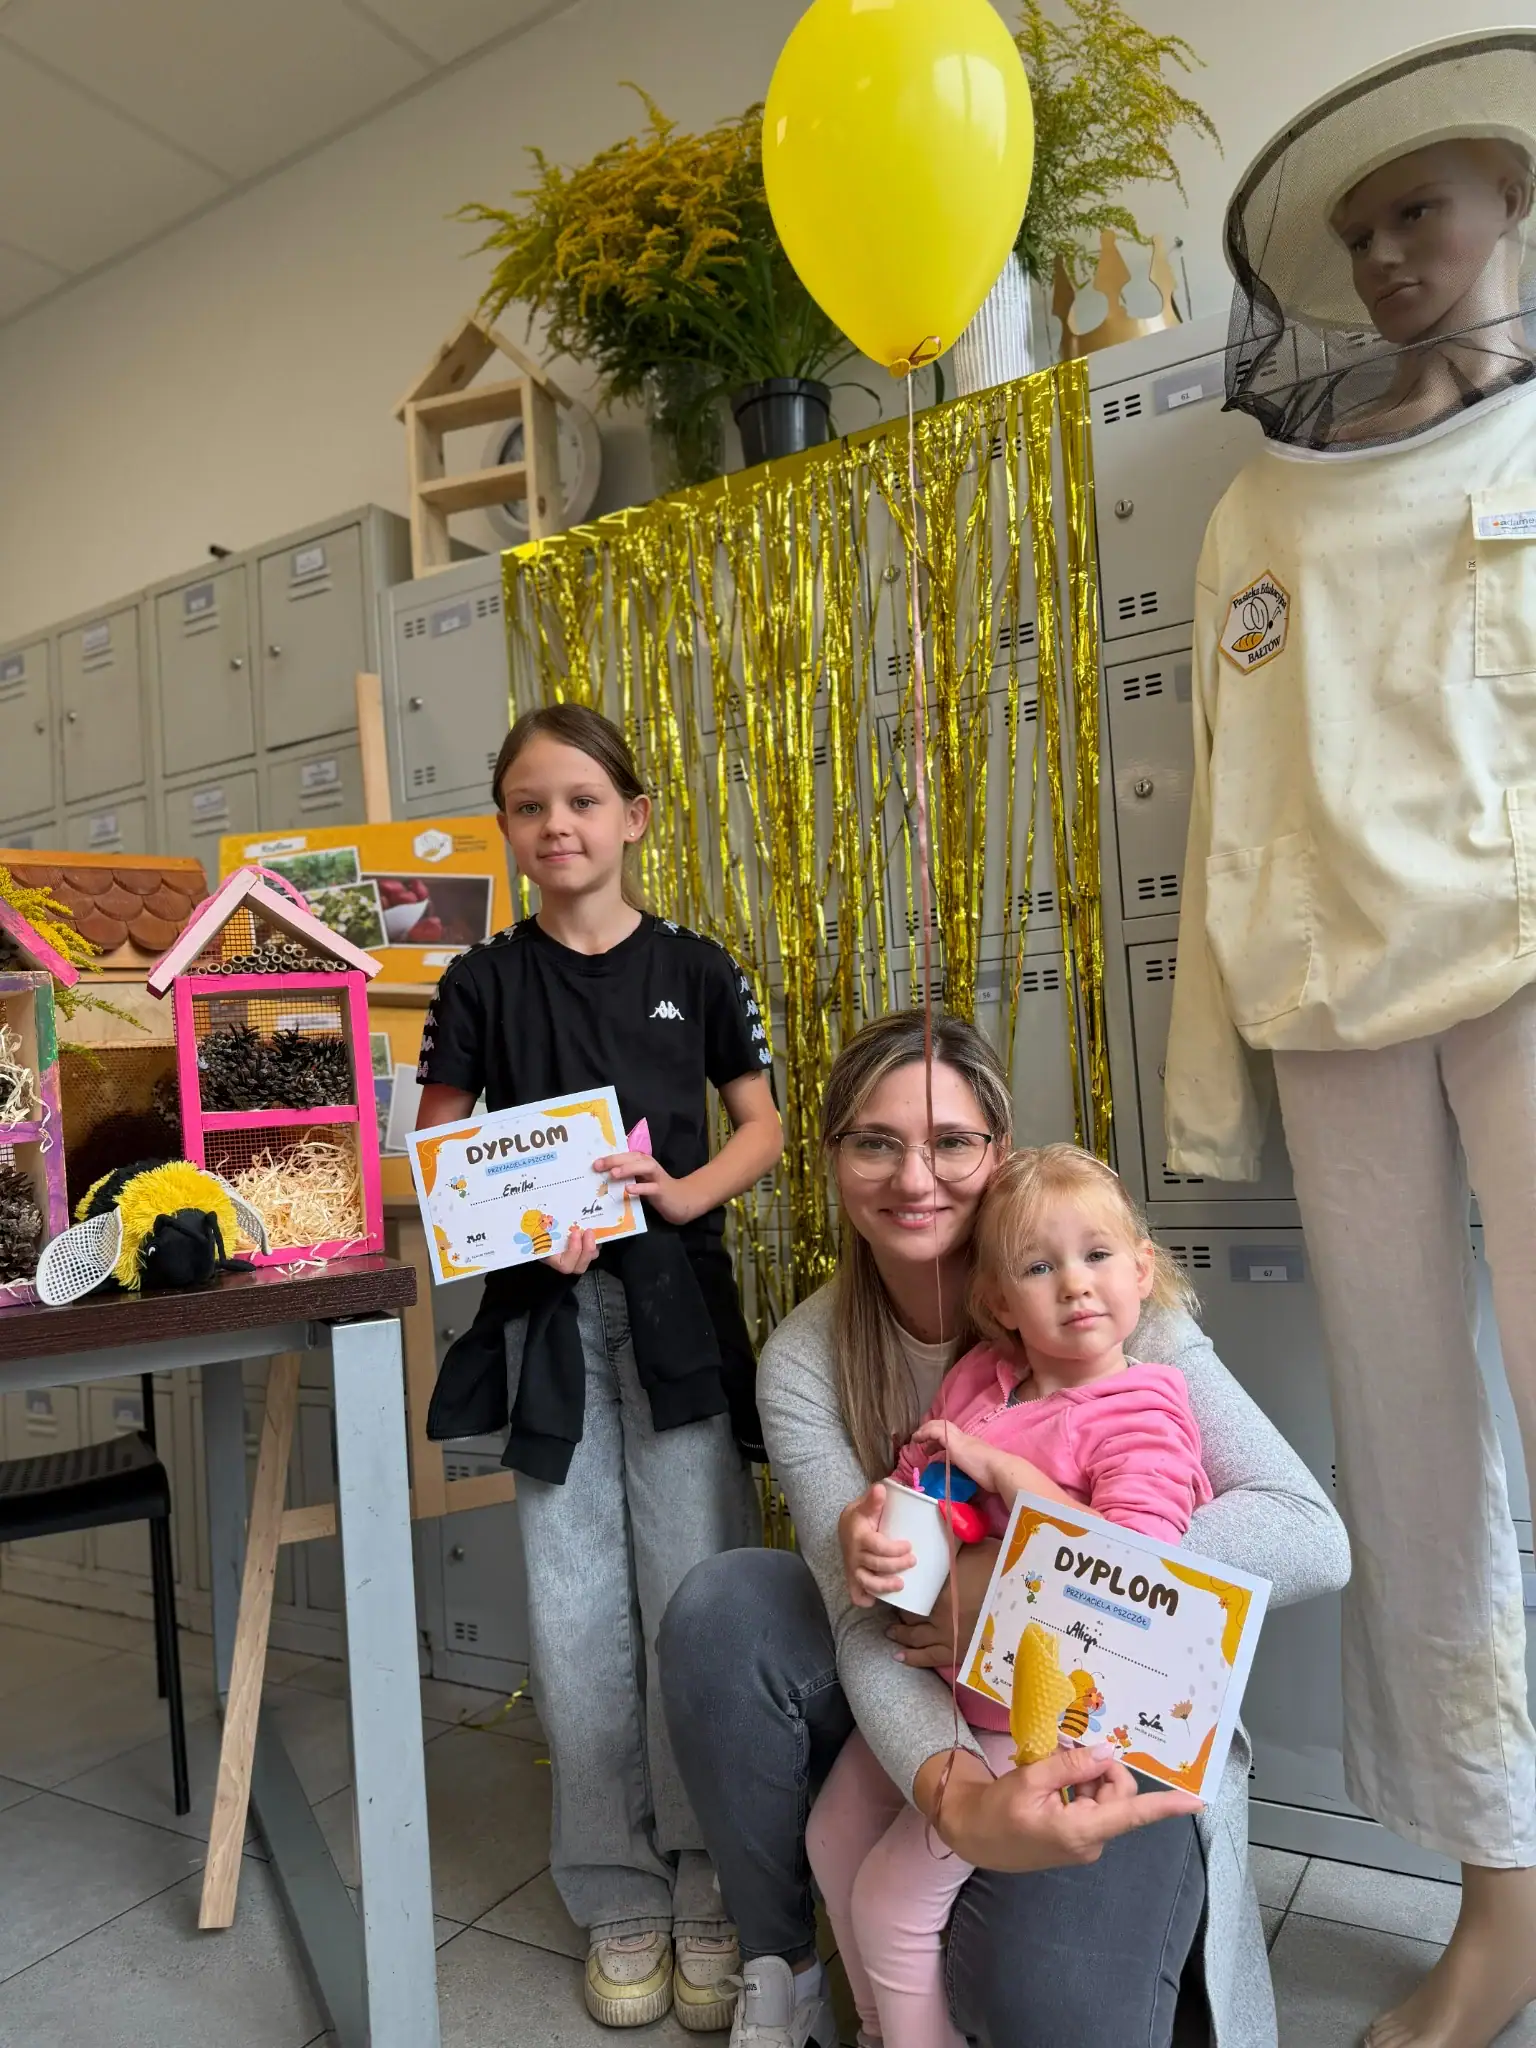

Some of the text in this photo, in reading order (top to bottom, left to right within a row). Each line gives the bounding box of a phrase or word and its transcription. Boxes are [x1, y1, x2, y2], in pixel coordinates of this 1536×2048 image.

[1180, 392, 1190, 401] 61
[1499, 516, 1536, 527] adame
[1232, 586, 1260, 610] Pasieka
[1247, 634, 1282, 665] BAŁTÓW
[982, 991, 991, 999] 56
[465, 1123, 570, 1166] DYPLOM
[1053, 1545, 1180, 1617] DYPLOM
[1064, 1586, 1148, 1627] PRZYJACIELA PSZCZÓŁ
